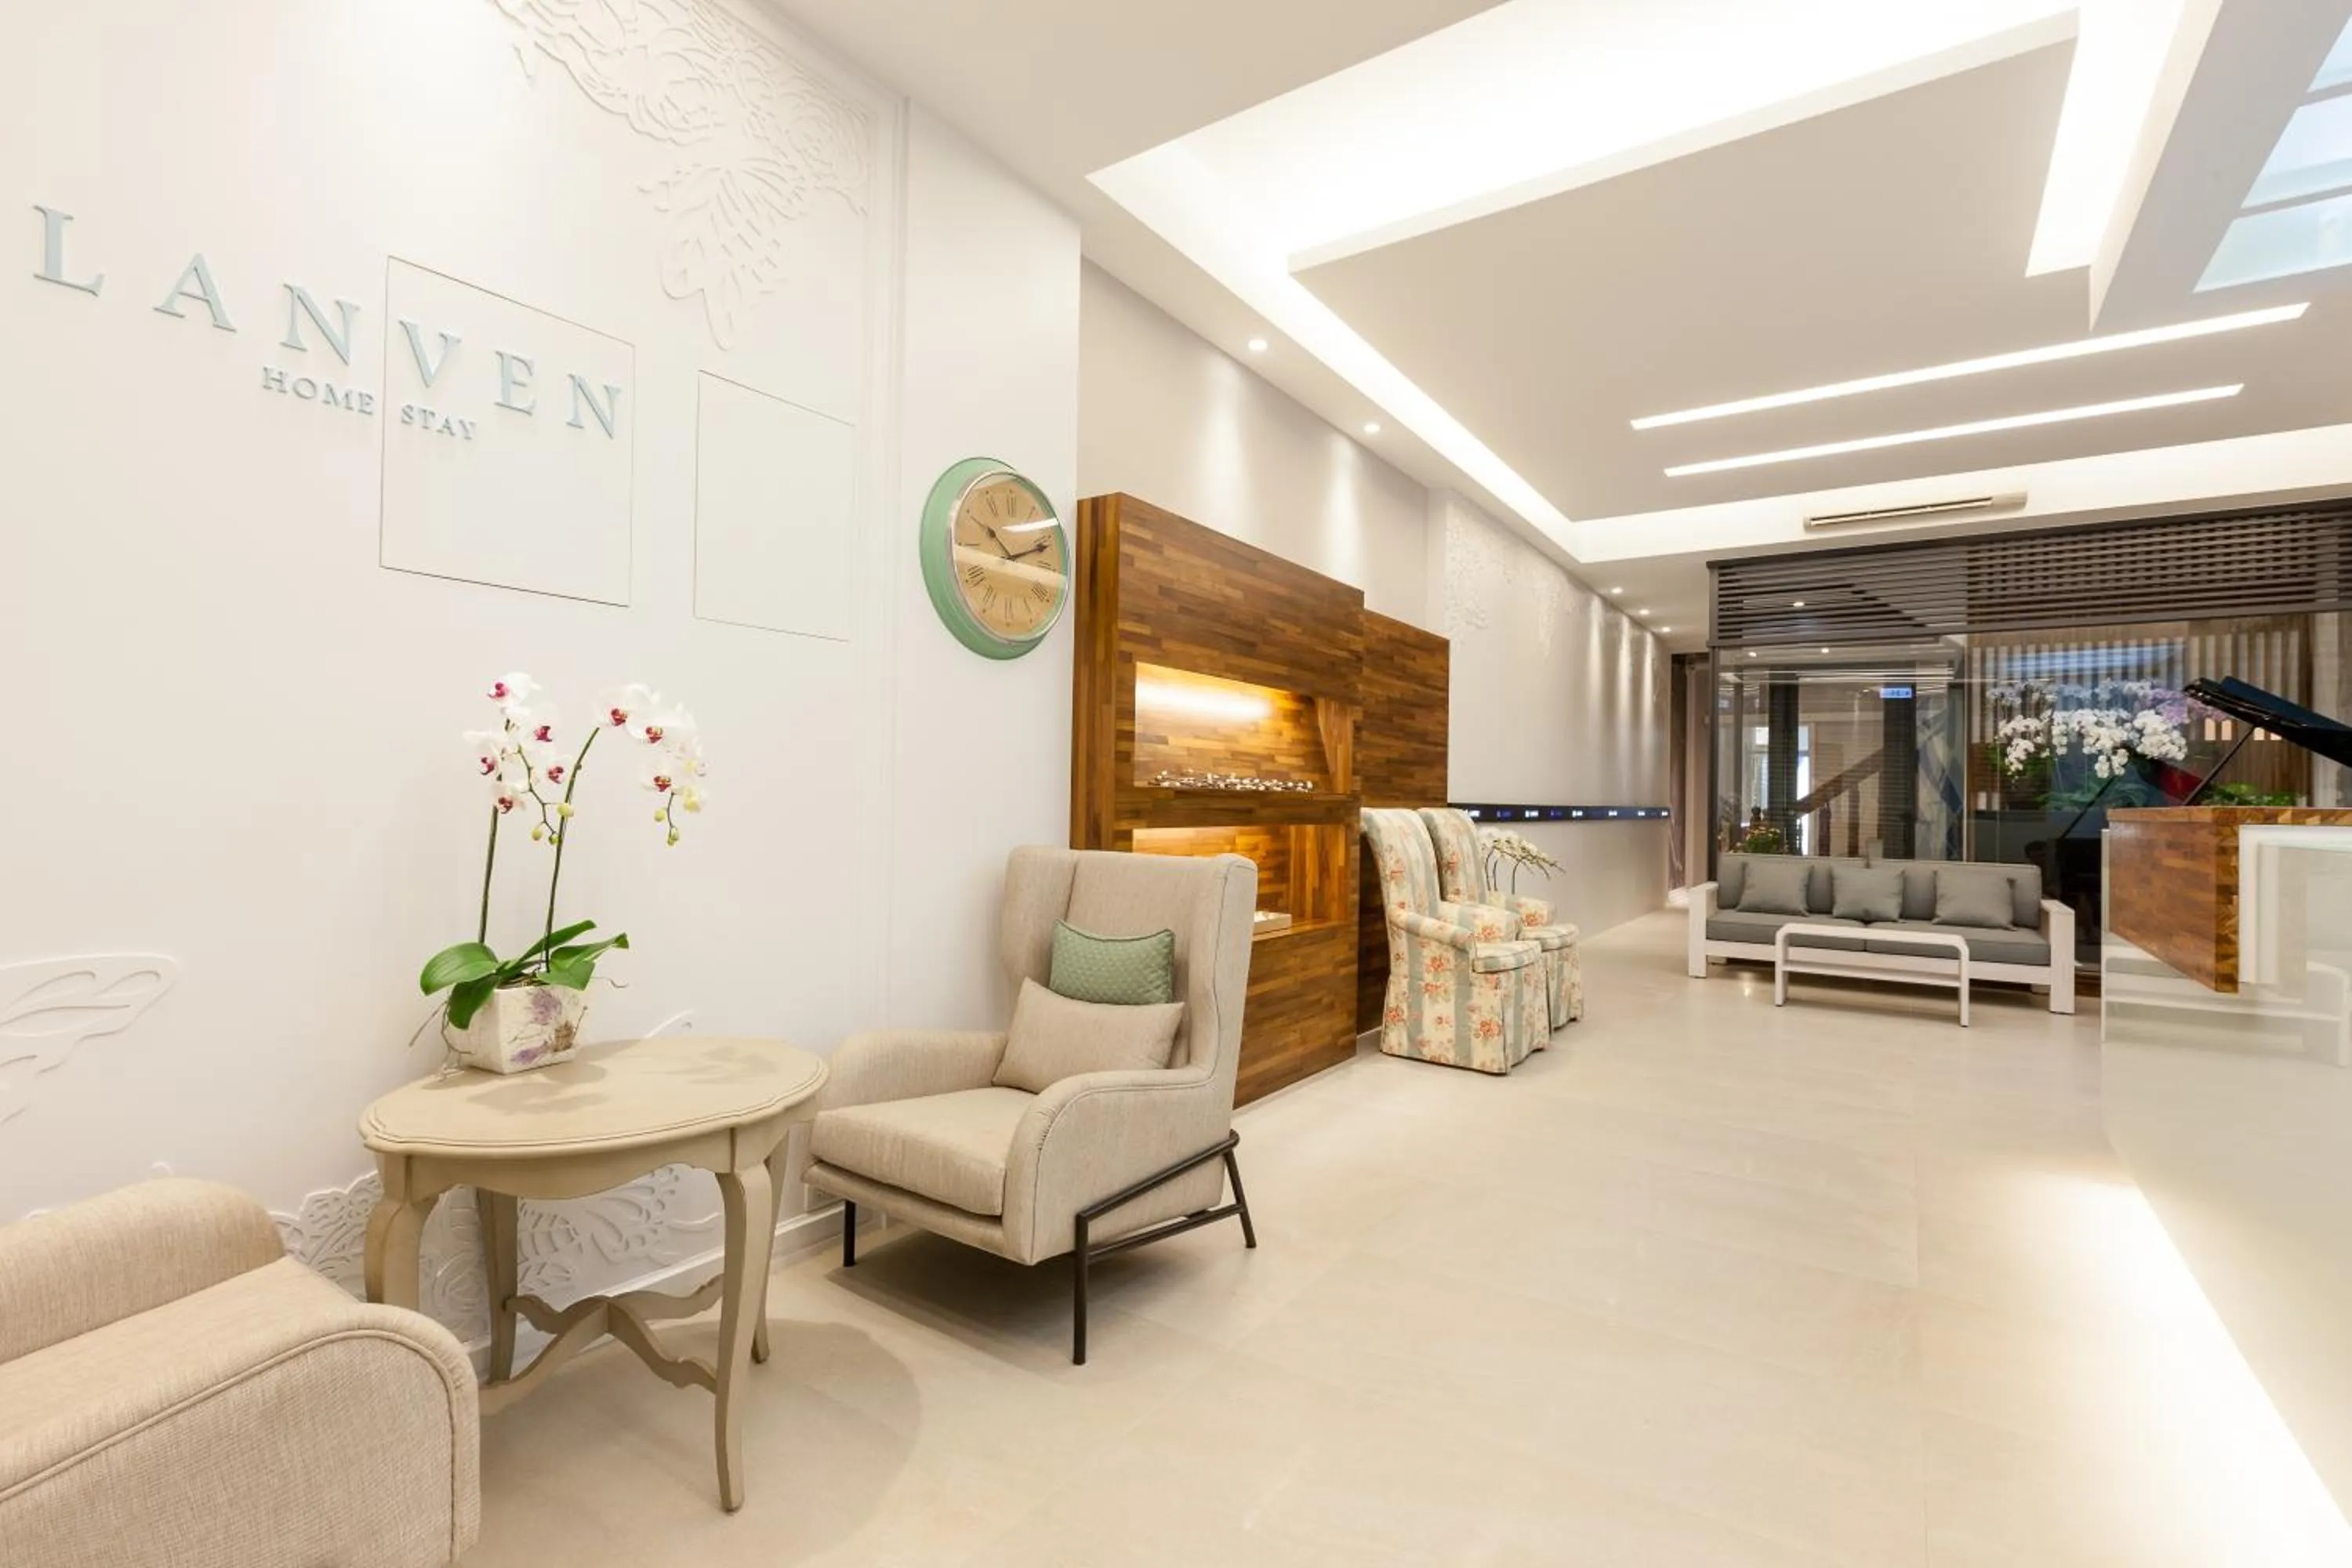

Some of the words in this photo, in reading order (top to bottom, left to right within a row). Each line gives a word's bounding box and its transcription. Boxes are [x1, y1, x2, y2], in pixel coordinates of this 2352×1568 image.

[33, 205, 622, 439] LANVEN
[262, 366, 375, 416] HOME
[401, 403, 477, 440] STAY
